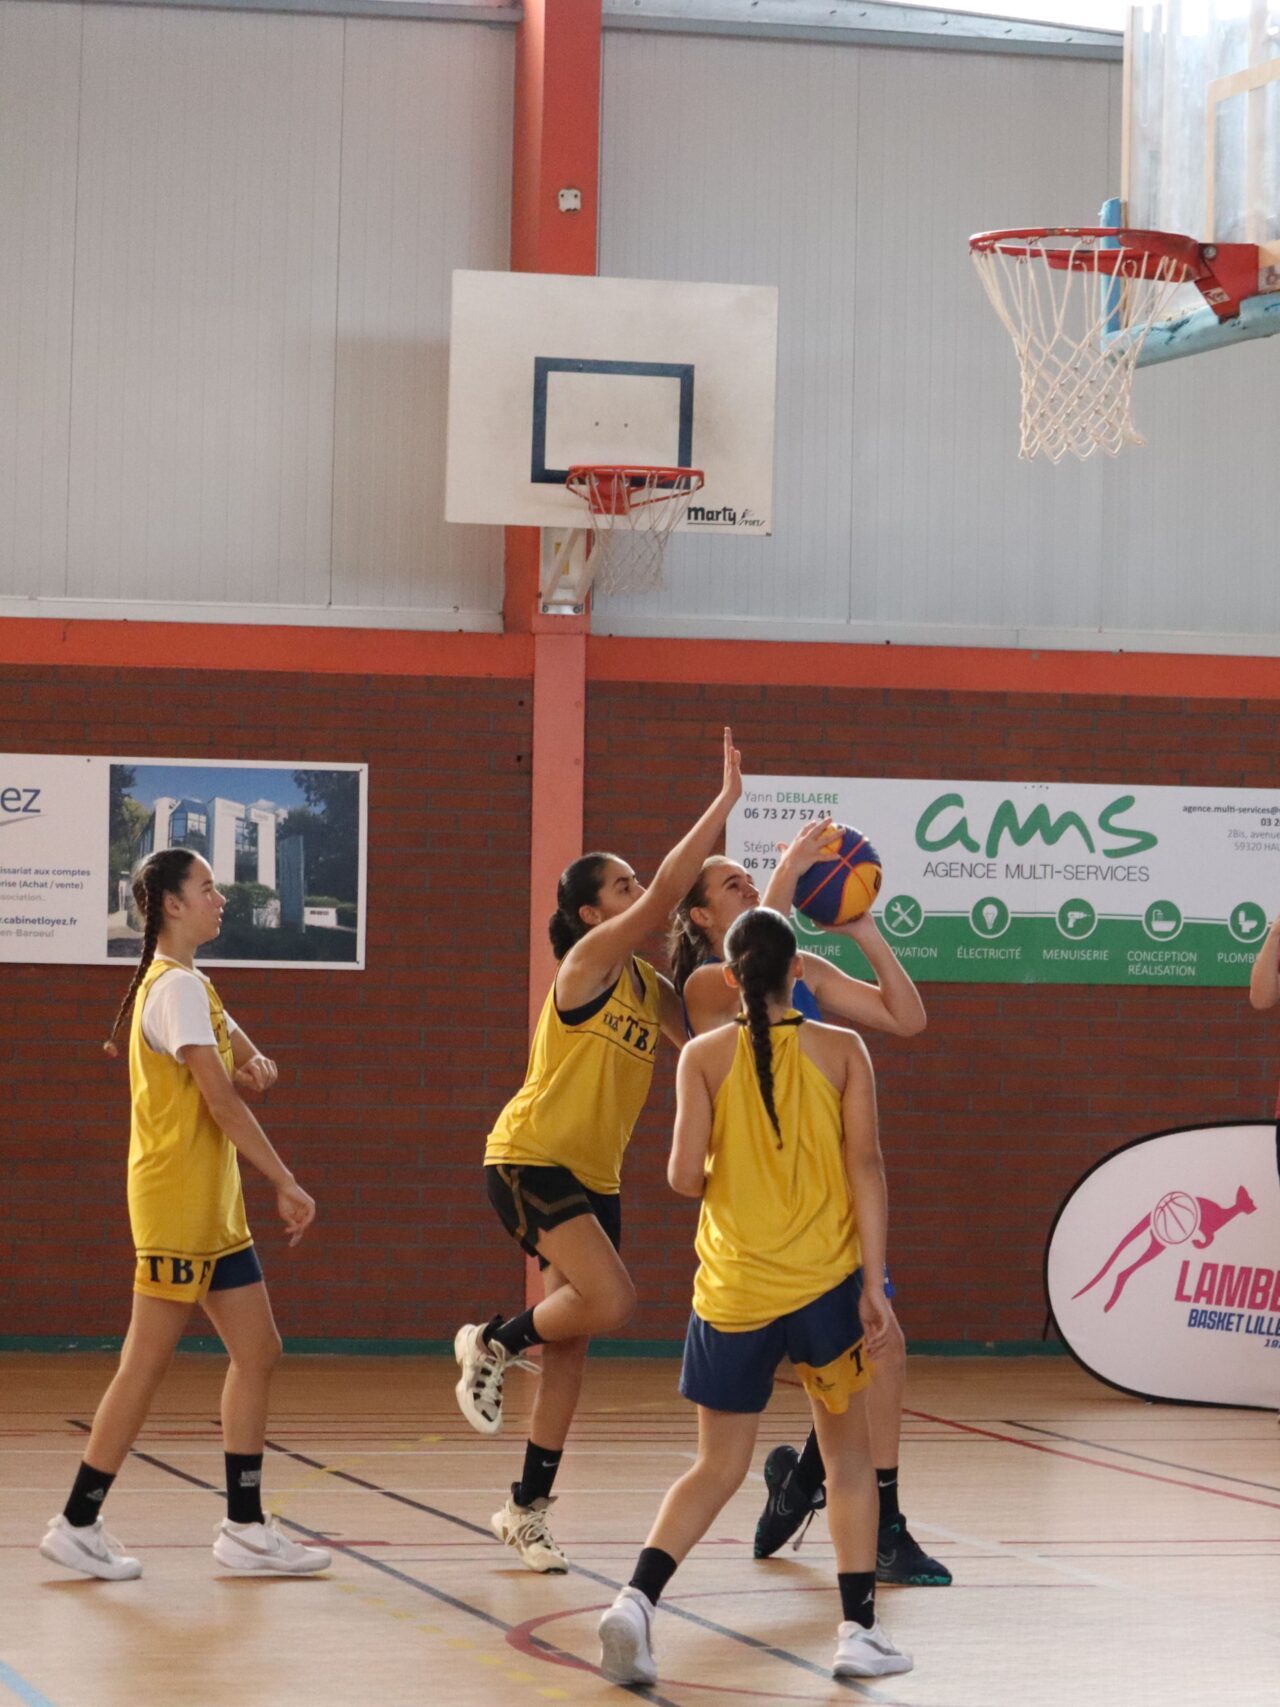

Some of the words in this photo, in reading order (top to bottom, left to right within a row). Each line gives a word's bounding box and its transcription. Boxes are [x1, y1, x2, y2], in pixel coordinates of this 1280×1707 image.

[0, 787, 41, 813] ez
[744, 791, 773, 803] Yann
[776, 792, 839, 804] DEBLAERE
[744, 808, 759, 819] 06
[763, 808, 777, 820] 73
[781, 808, 796, 820] 27
[800, 809, 814, 820] 57
[818, 810, 832, 820] 41
[915, 793, 1158, 858] ams
[1260, 817, 1272, 827] 03
[1250, 831, 1280, 839] avenue
[743, 841, 778, 854] Stéph
[743, 858, 759, 869] 06
[762, 859, 777, 869] 73
[52, 869, 91, 877] comptes
[923, 862, 997, 879] AGENCE
[1005, 864, 1150, 882] MULTI-SERVICES
[19, 880, 48, 889] (Achat
[56, 882, 83, 890] vente)
[0, 915, 77, 927] .cabinetloyez.fr
[891, 946, 937, 958] OVATION
[956, 946, 1021, 960] ÉLECTRICITÉ
[1043, 949, 1109, 961] MENUISERIE
[1127, 950, 1197, 962] CONCEPTION
[1128, 963, 1196, 976] RÉALISATION
[1188, 1308, 1244, 1333] BASKET
